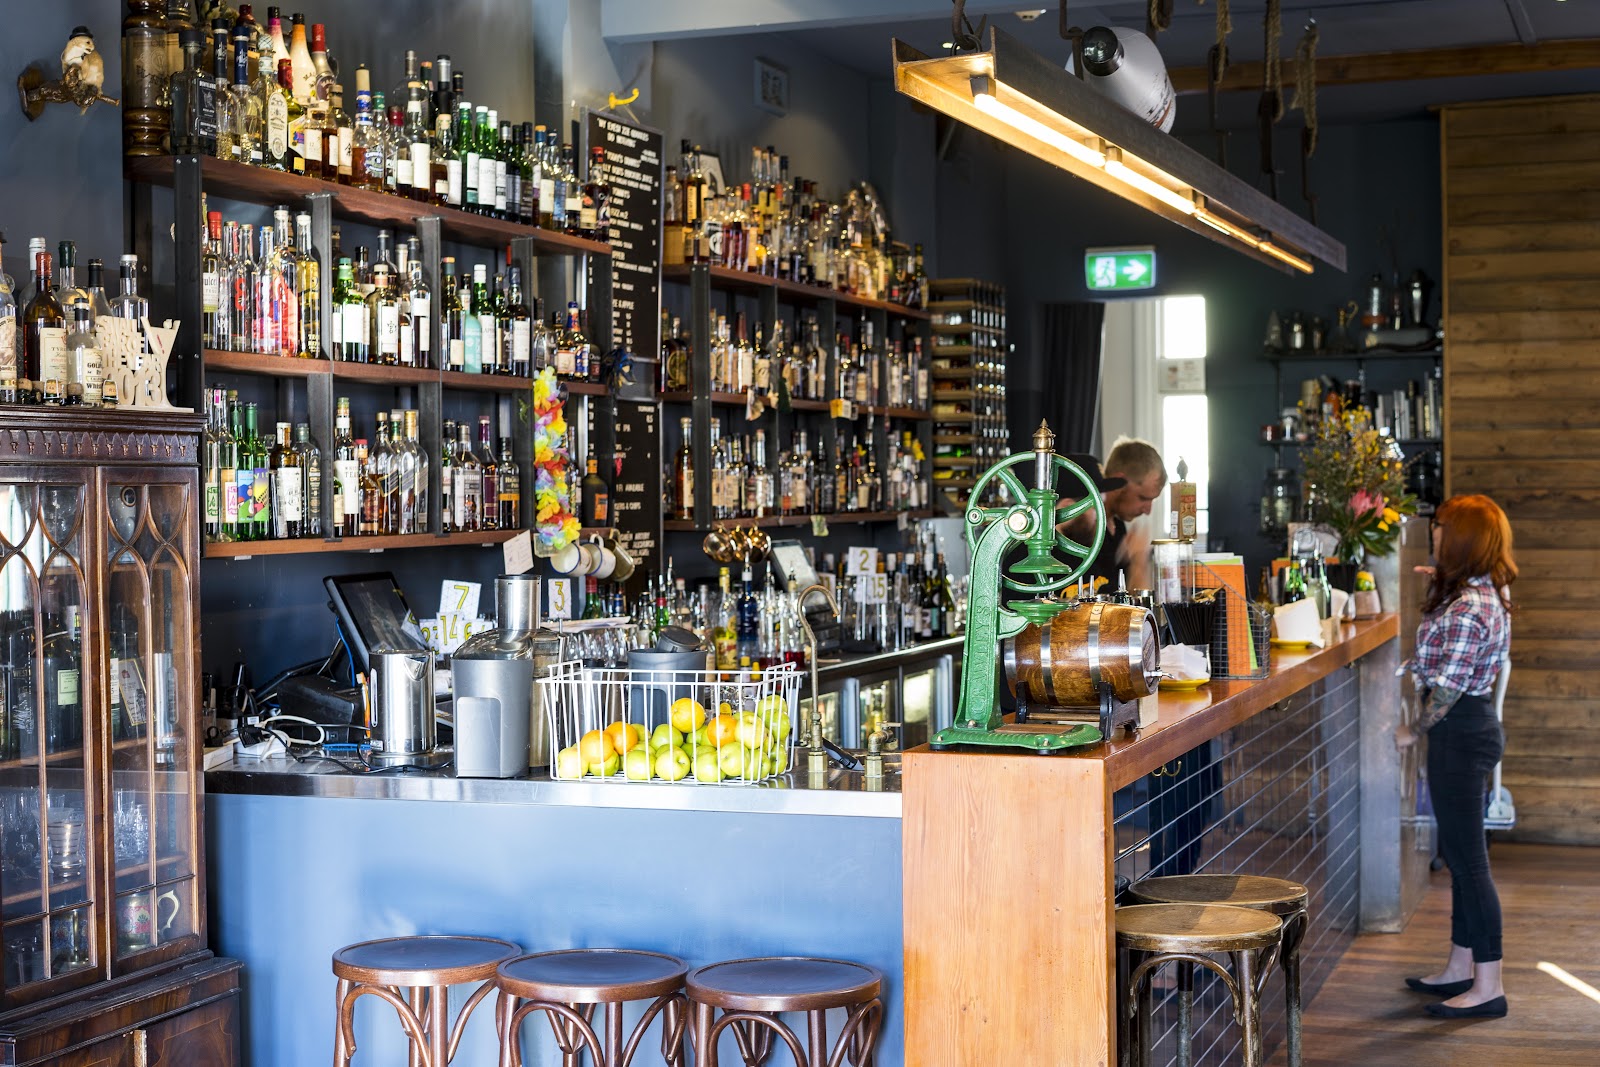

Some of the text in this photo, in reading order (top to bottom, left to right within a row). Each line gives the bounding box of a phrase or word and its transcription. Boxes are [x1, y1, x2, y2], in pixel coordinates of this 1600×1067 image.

[860, 549, 869, 571] 2
[453, 585, 469, 611] 7
[554, 581, 565, 611] 3
[871, 576, 886, 599] 15
[440, 615, 458, 646] 14
